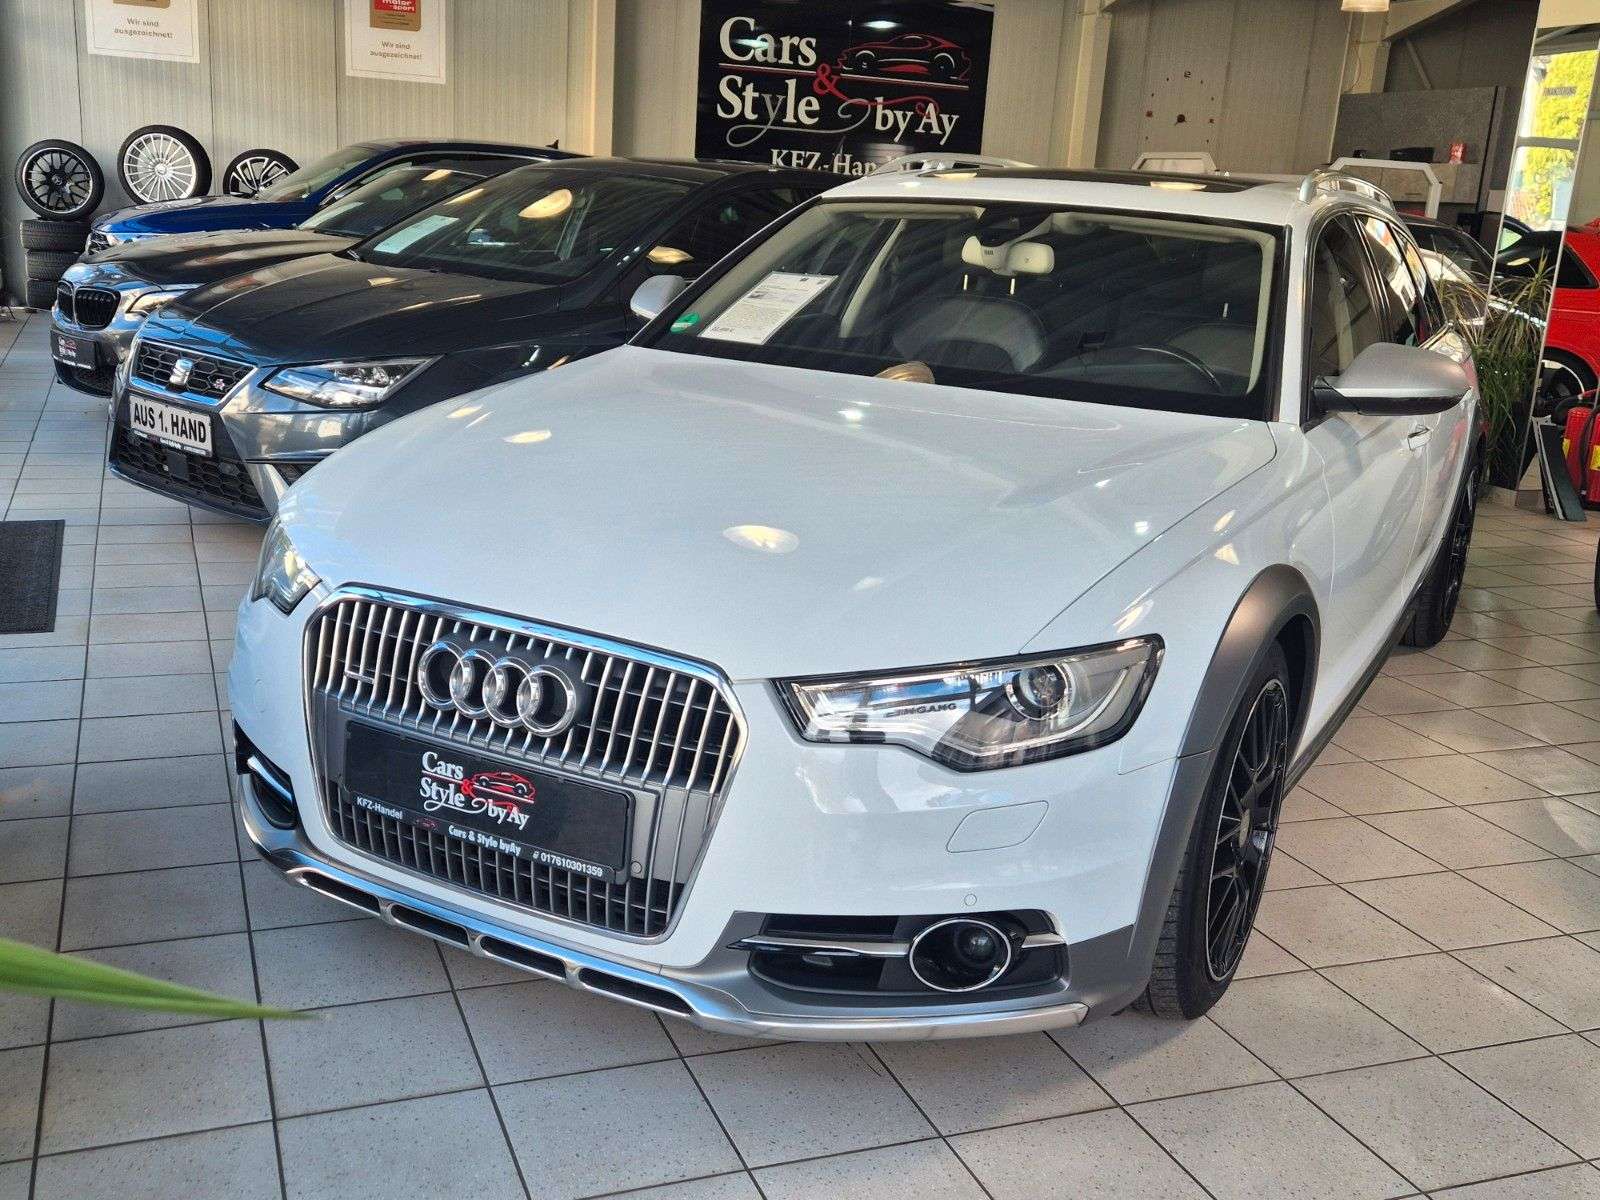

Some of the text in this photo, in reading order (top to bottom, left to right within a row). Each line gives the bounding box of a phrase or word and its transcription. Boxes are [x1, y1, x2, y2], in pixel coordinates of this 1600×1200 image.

[127, 17, 159, 27] Wir sind
[382, 40, 411, 50] Wir sind
[719, 16, 817, 67] Cars
[812, 63, 843, 98] &
[717, 74, 821, 147] Style
[134, 402, 156, 429] AUS
[158, 410, 168, 433] 1.
[171, 413, 207, 444] HAND
[421, 750, 464, 780] Cars
[419, 776, 466, 811] Style
[461, 778, 476, 798] &
[356, 796, 403, 820] KFZ-Handel
[448, 824, 467, 840] Cars
[468, 830, 476, 842] &
[477, 832, 498, 849] Style
